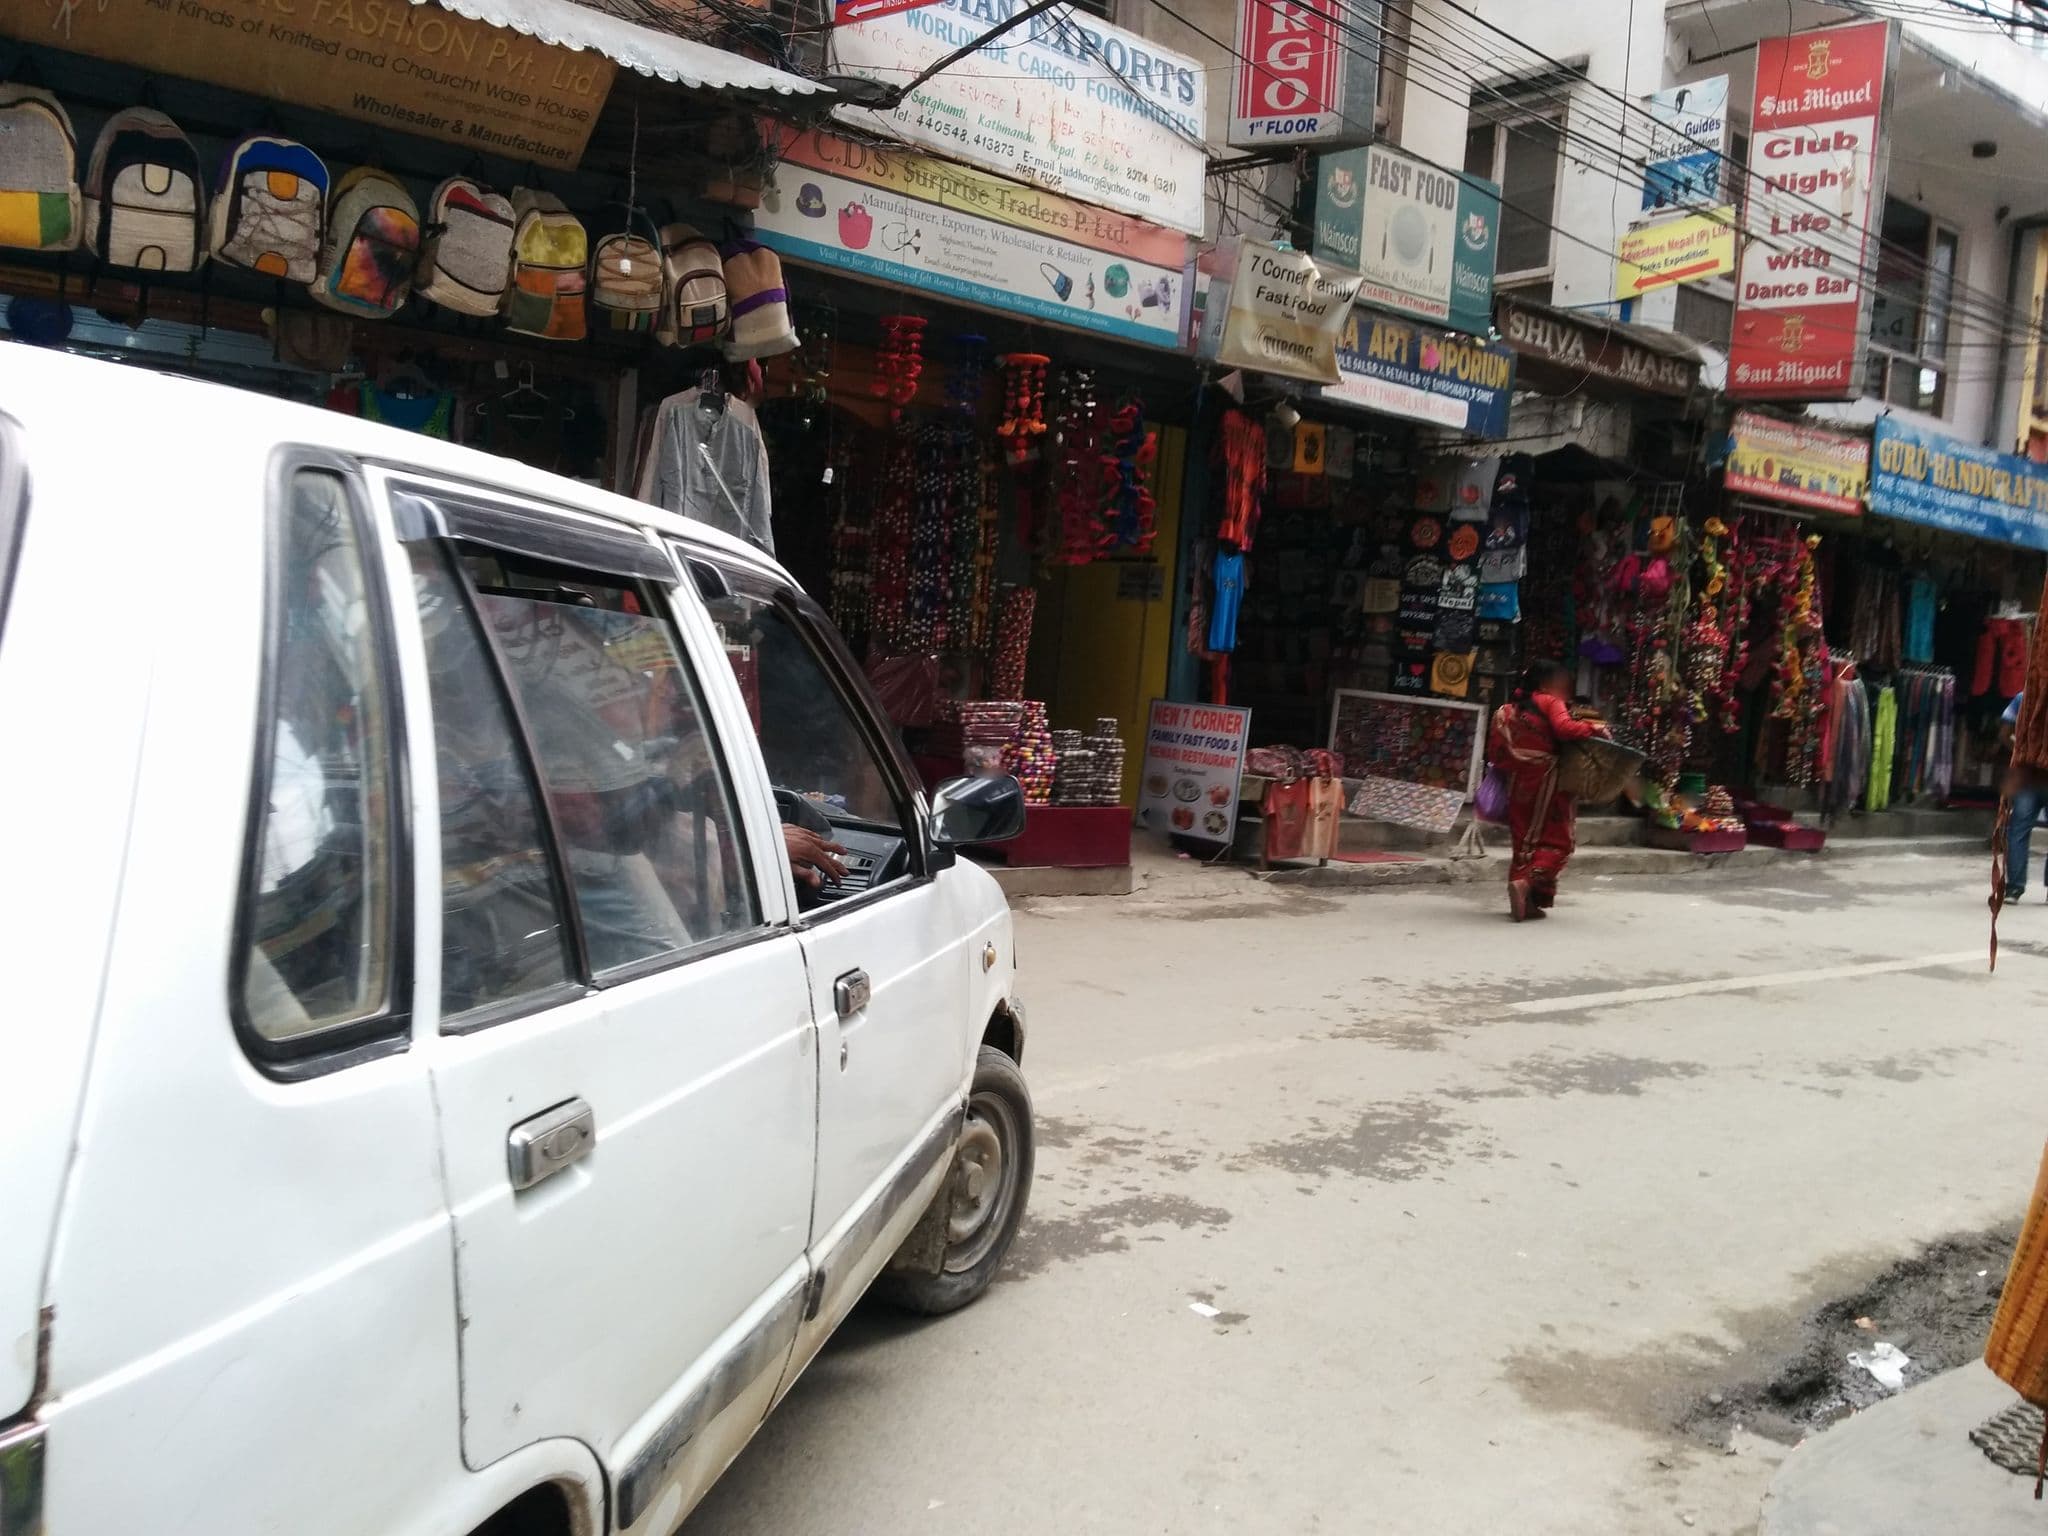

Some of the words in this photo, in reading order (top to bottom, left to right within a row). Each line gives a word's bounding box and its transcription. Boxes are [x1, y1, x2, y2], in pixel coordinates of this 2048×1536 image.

[176, 0, 236, 29] Kinds
[240, 18, 265, 34] of
[268, 22, 341, 57] Knitted
[345, 47, 385, 69] and
[486, 83, 532, 107] Ware
[535, 97, 591, 123] House
[311, 0, 479, 62] FASHION
[486, 38, 536, 82] Pvt.
[551, 56, 600, 100] Ltd.
[1027, 13, 1195, 105] EXPORTS
[1017, 51, 1076, 92] CARGO
[1760, 95, 1799, 117] San
[1800, 80, 1872, 112] Miguel
[352, 91, 449, 134] Wholesaler
[450, 118, 465, 135] &
[467, 122, 574, 162] Manufacturer
[892, 106, 911, 123] Tel:
[1023, 150, 1055, 171] E-mail
[1248, 120, 1263, 136] 1st
[1265, 118, 1319, 136] FLOOR
[1685, 117, 1721, 137] Guides
[1763, 130, 1861, 160] Club
[813, 131, 896, 181] C.D.S.
[903, 158, 991, 209] Surprise
[996, 187, 1069, 228] Traders
[1074, 210, 1090, 234] P.
[1369, 153, 1411, 198] FAST
[1415, 168, 1457, 211] FOOD
[1764, 166, 1853, 195] Night
[860, 191, 940, 227] Manufacturer,
[941, 214, 989, 241] Exporter,
[989, 226, 1044, 255] Wholesaler
[1046, 244, 1055, 256] &
[1319, 219, 1360, 256] Wainscot
[1769, 212, 1831, 236] Life
[870, 260, 885, 273] All
[1767, 245, 1831, 271] with
[1250, 255, 1261, 272] 7
[1262, 258, 1309, 286] Corner
[1314, 276, 1354, 304] amily
[1256, 286, 1290, 307] Fast
[1744, 281, 1809, 301] Dance
[1814, 275, 1854, 295] Bar
[1368, 322, 1413, 366] ART
[1418, 333, 1511, 391] EMPORIUM
[1509, 310, 1586, 360] SHIVA
[1619, 346, 1689, 386] MARG
[1735, 362, 1772, 384] San
[1774, 359, 1843, 385] Miguel
[1153, 704, 1179, 726] NEW
[1182, 708, 1190, 726] 7
[1192, 707, 1243, 735] CORNER
[1151, 729, 1181, 743] FAMILY
[1181, 732, 1205, 747] FAST
[1205, 735, 1231, 750] FOOD
[1231, 740, 1239, 752] &
[1182, 750, 1238, 769] RESTAURANT
